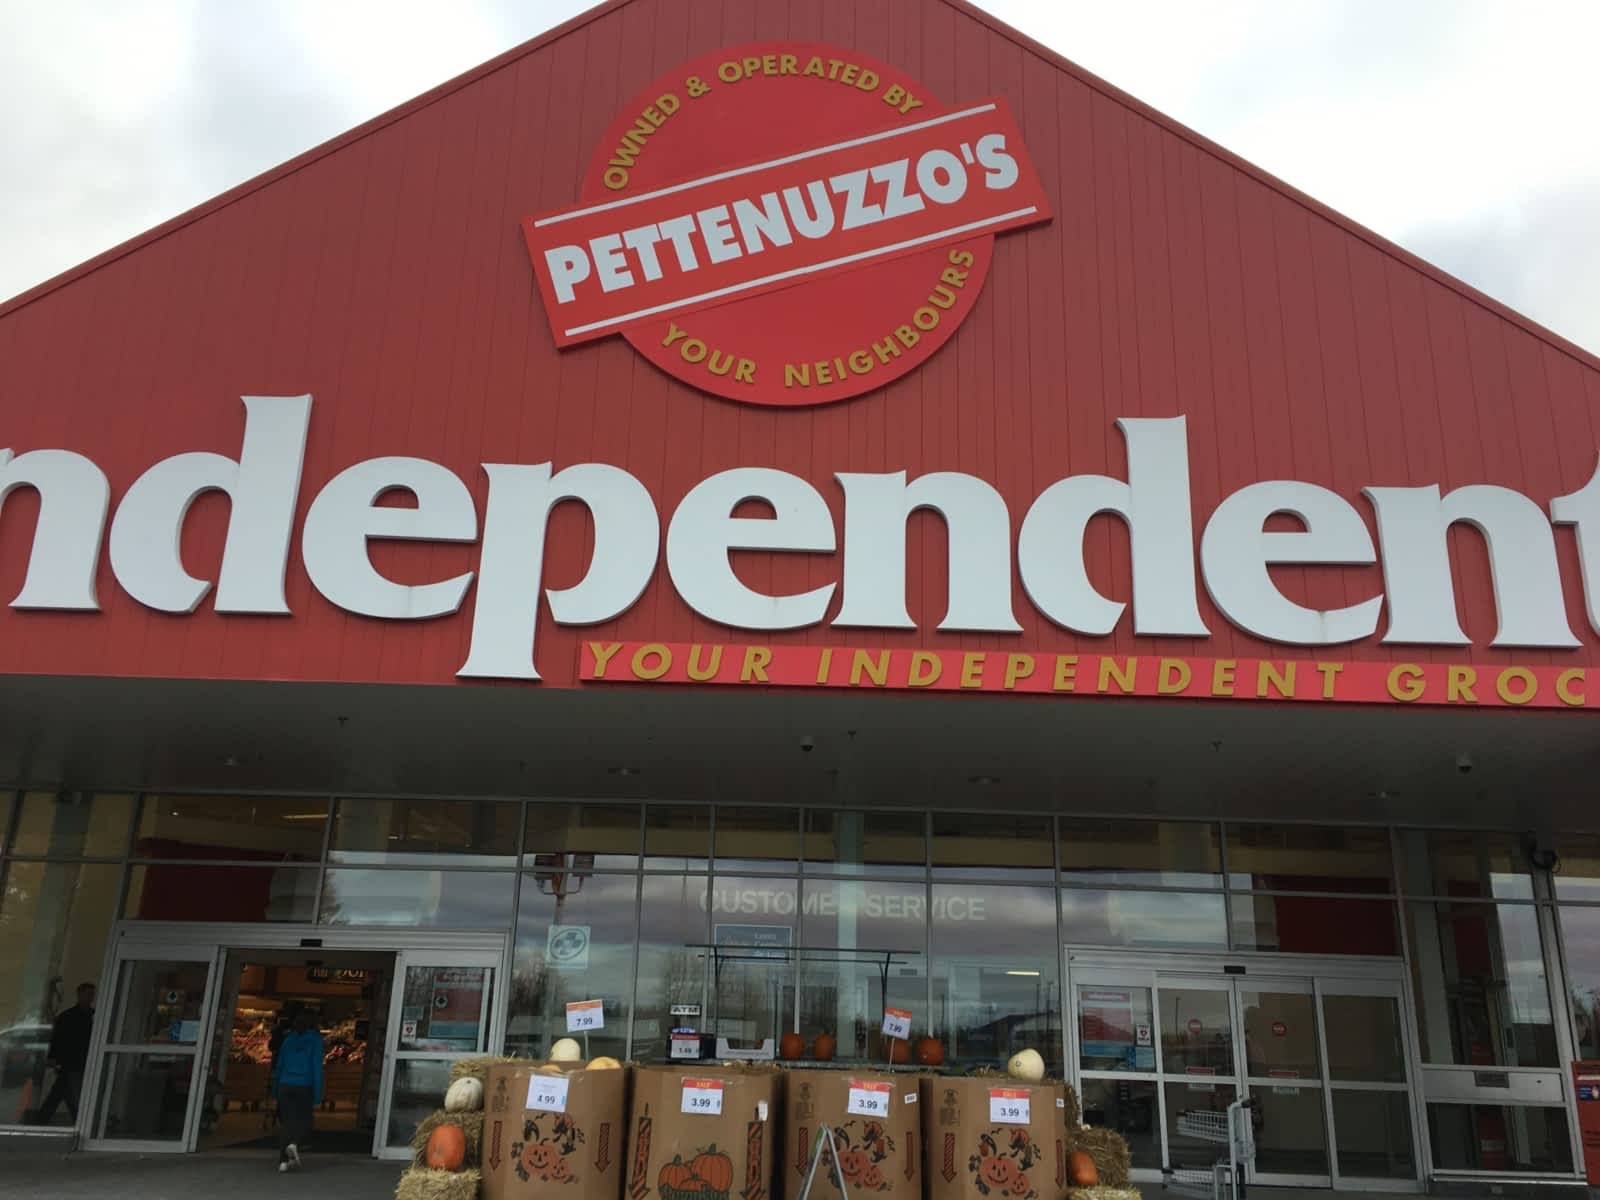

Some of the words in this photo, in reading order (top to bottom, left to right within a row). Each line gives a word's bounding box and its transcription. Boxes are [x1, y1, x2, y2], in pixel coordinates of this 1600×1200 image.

[603, 92, 681, 191] OWNED
[686, 75, 711, 98] &
[717, 53, 880, 93] OPERATED
[881, 84, 923, 115] BY
[544, 133, 1019, 305] PETTENUZZO'S
[661, 322, 757, 385] YOUR
[784, 247, 975, 388] NEIGHBOURS
[588, 641, 773, 683] YOUR
[815, 646, 1343, 699] INDEPENDENT
[1386, 663, 1587, 707] GROC
[863, 894, 986, 921] SERVICE
[672, 1006, 699, 1014] ATM
[576, 1017, 593, 1027] 7.99
[691, 1098, 711, 1108] 3.99
[858, 1099, 878, 1110] 3.99
[1000, 1107, 1020, 1117] 3.99
